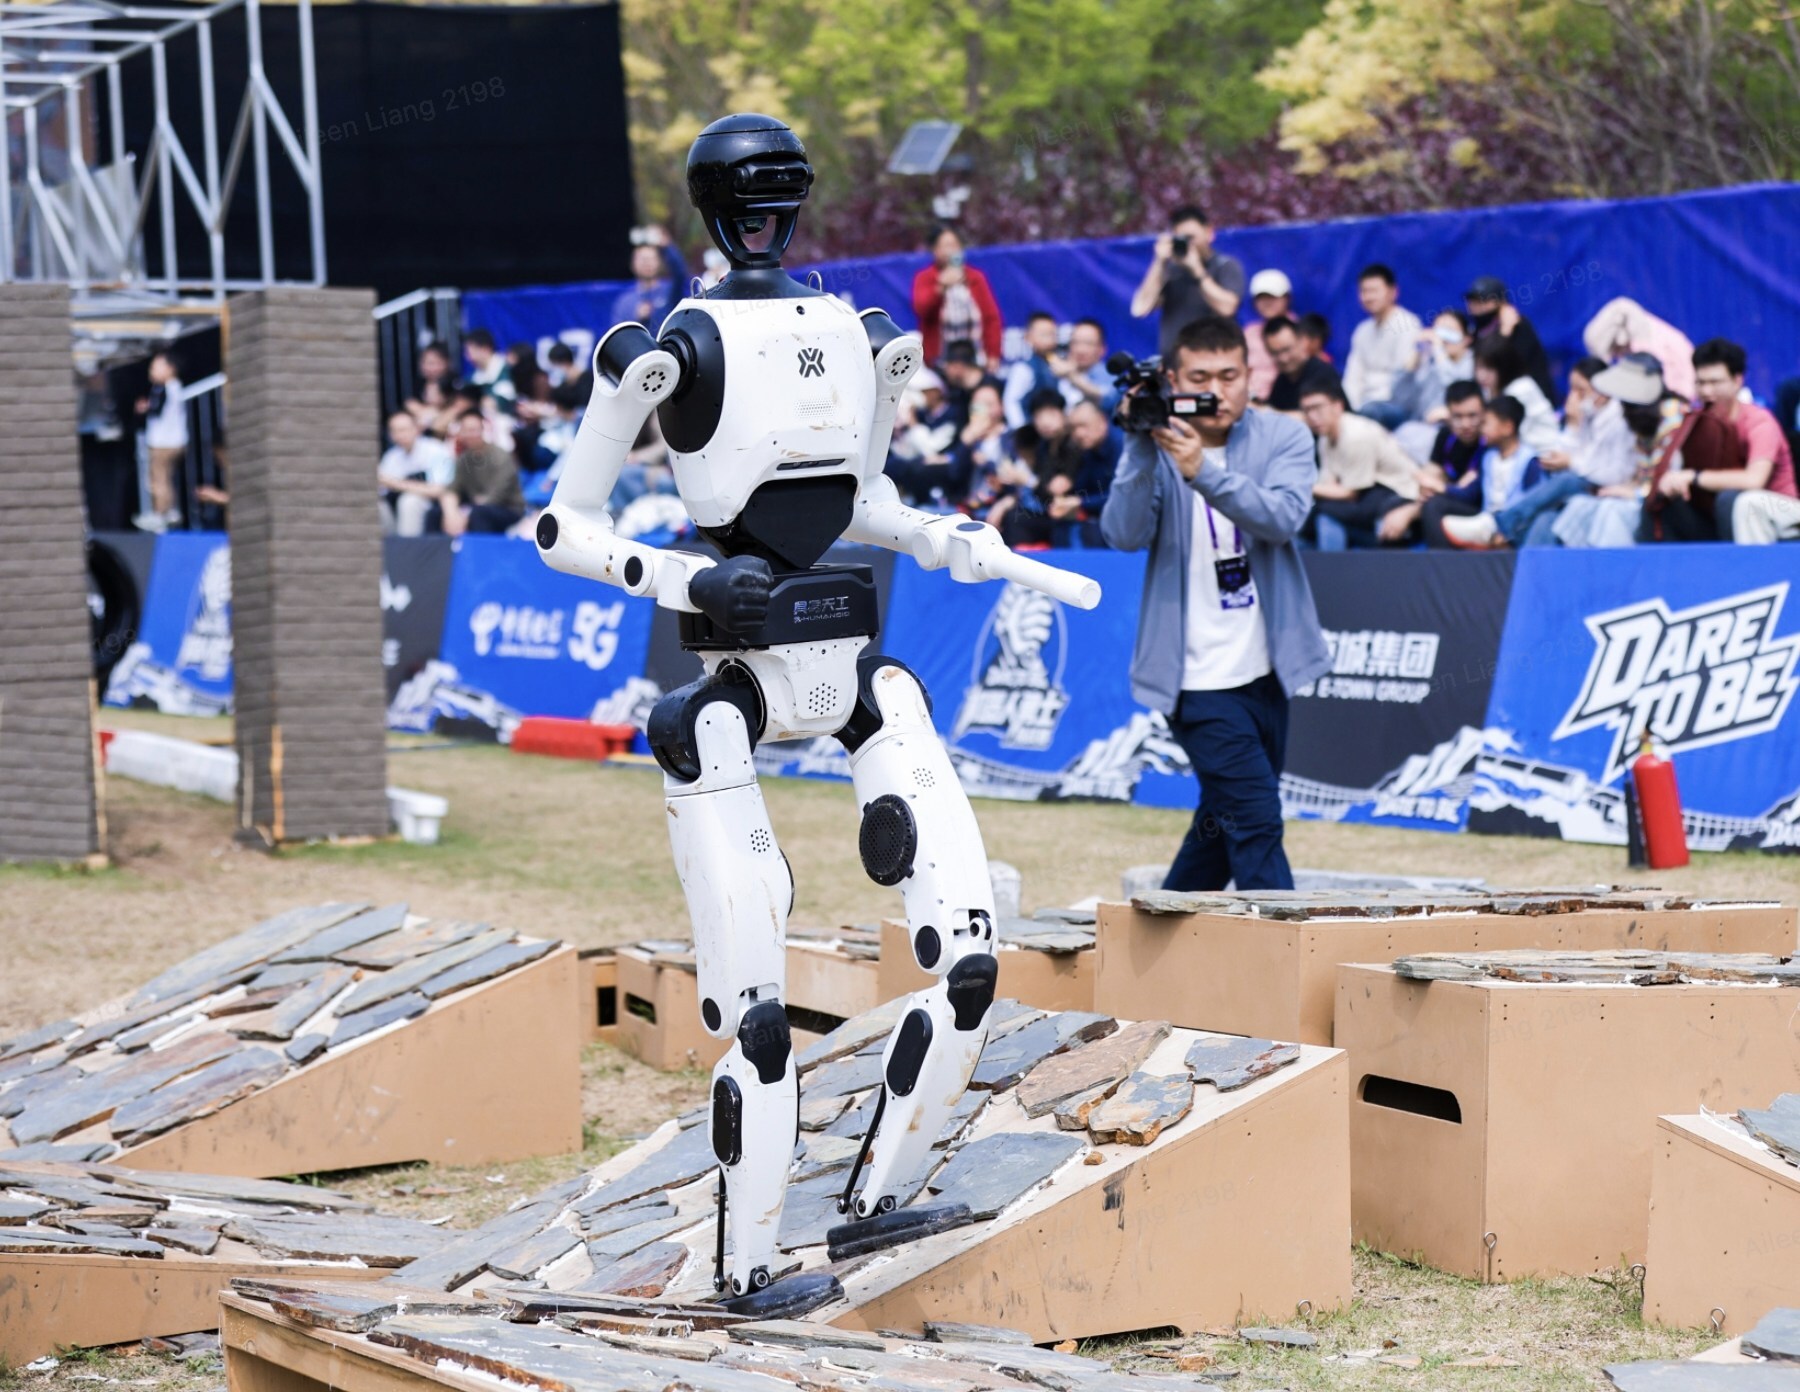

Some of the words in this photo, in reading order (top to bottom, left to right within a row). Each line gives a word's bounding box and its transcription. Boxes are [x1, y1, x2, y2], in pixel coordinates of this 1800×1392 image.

[1580, 600, 1773, 717] DARE
[1622, 672, 1702, 756] TO
[1692, 650, 1793, 735] BE
